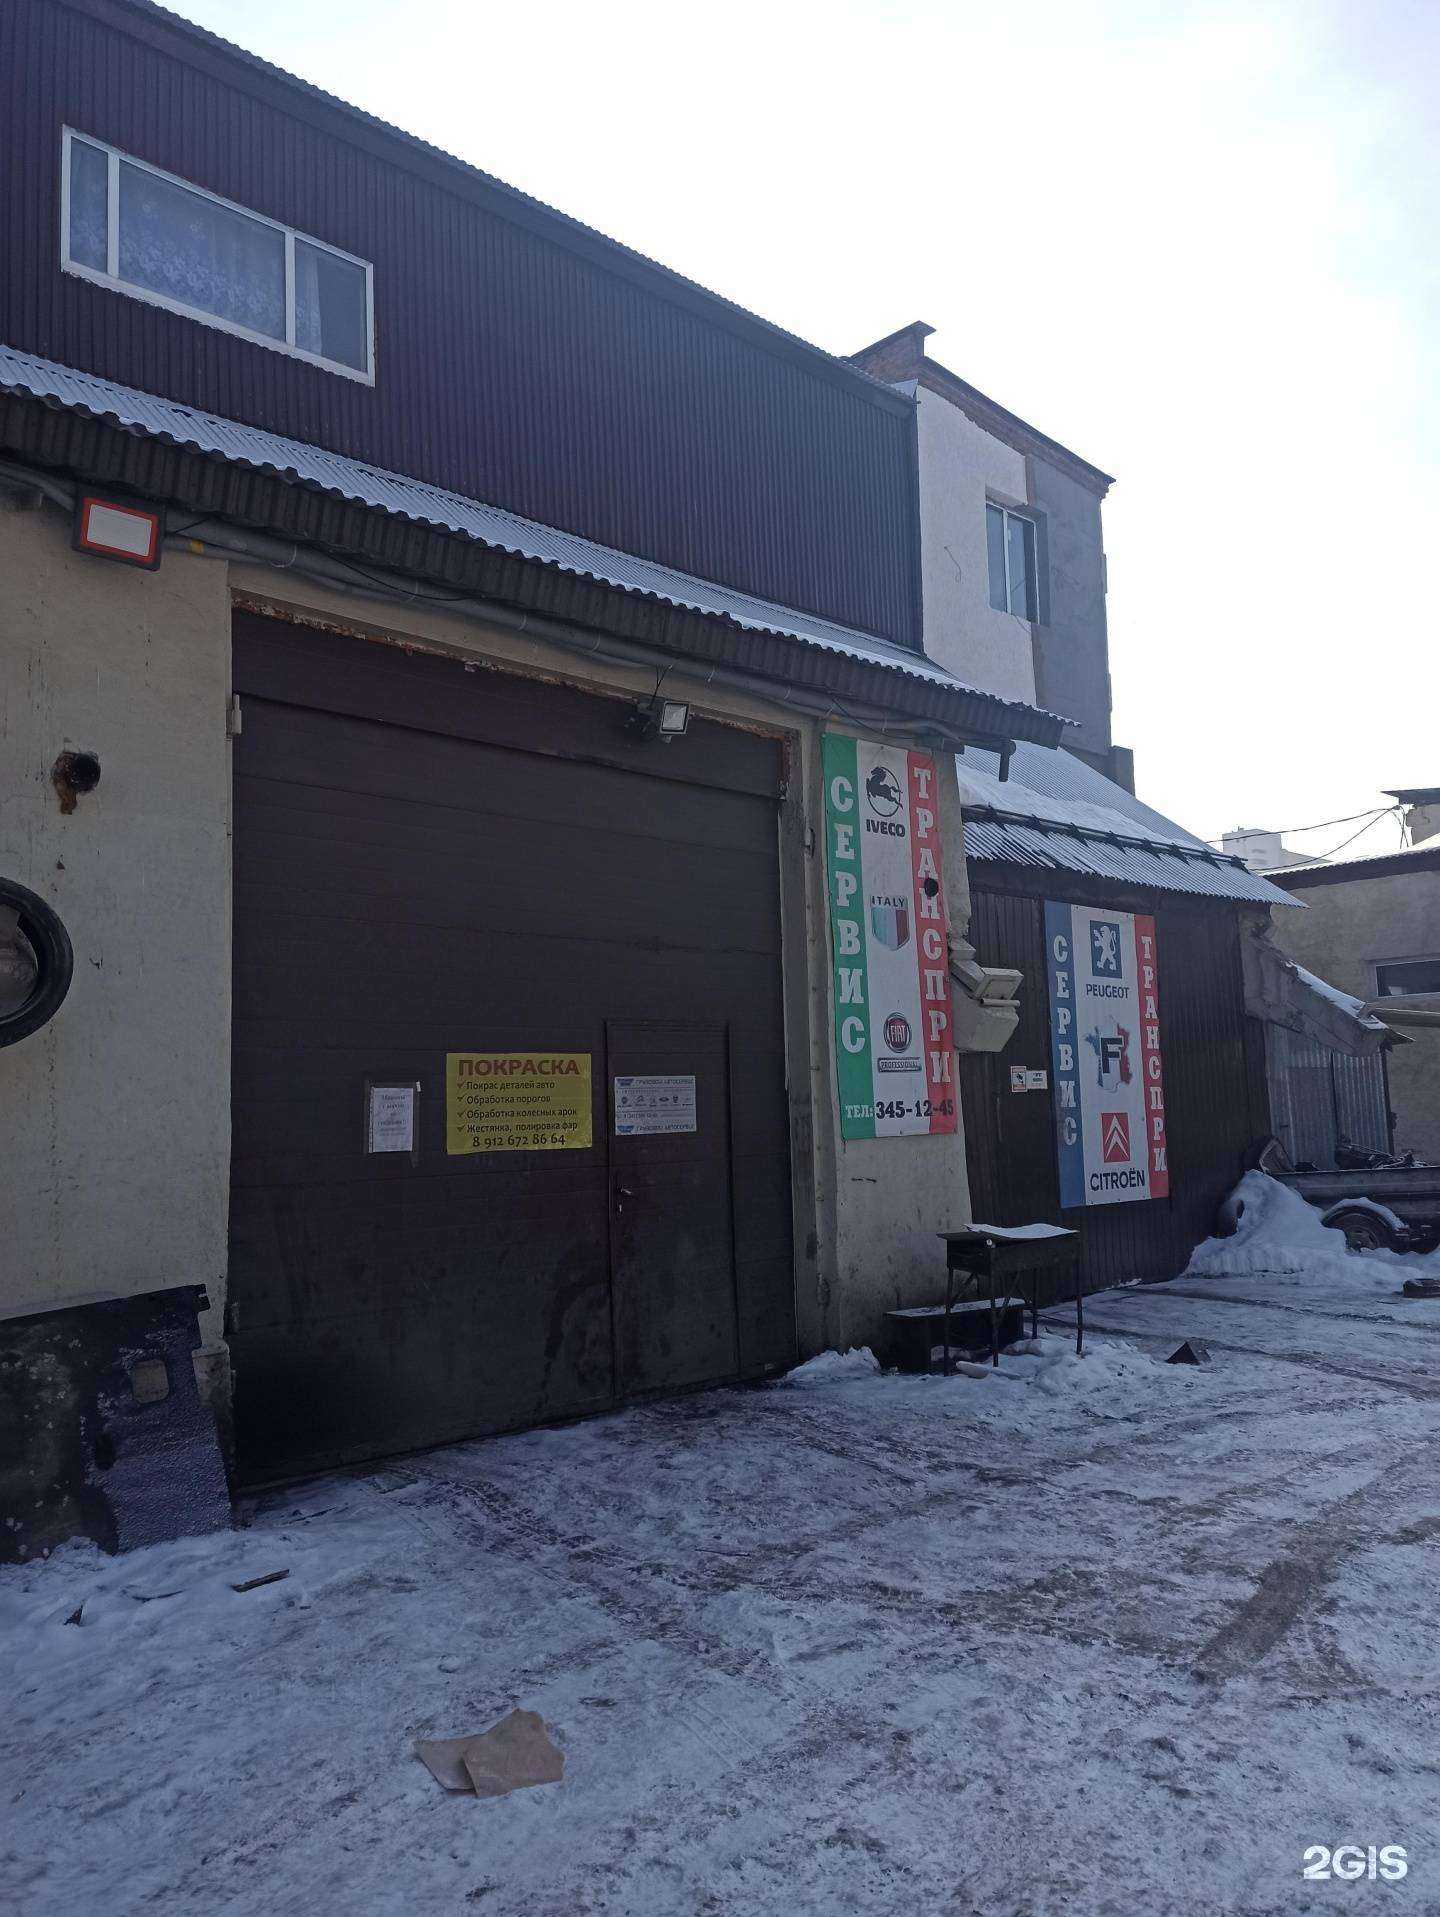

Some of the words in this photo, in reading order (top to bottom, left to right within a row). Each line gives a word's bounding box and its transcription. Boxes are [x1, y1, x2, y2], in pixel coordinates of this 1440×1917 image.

[865, 819, 906, 837] IVECO
[872, 896, 905, 908] ITALY
[831, 776, 866, 1053] СЕРВИС
[914, 767, 951, 1083] ТРАНСПРИ
[1086, 984, 1130, 998] PEUGEOT
[890, 1025, 906, 1043] FIAT
[1054, 935, 1077, 1145] СЕРВИС
[1101, 1038, 1124, 1074] F
[1142, 936, 1167, 1171] ТРАНСПРИ
[458, 1059, 580, 1076] ПОКРАСКА
[467, 1081, 498, 1092] Покрас
[500, 1081, 534, 1091] деталей
[467, 1095, 514, 1105] Обработка
[516, 1096, 551, 1104] порогов
[467, 1110, 514, 1119] Обработка
[516, 1110, 556, 1118] колесных
[558, 1108, 577, 1117] арок
[467, 1124, 512, 1133] Жестянка,
[516, 1122, 560, 1131] полировка
[562, 1121, 578, 1131] фар
[472, 1136, 480, 1147] 8
[484, 1137, 504, 1148] 912
[508, 1135, 528, 1148] 672
[532, 1133, 547, 1145] 86
[551, 1133, 566, 1145] 64
[1090, 1168, 1145, 1191] CITROËN
